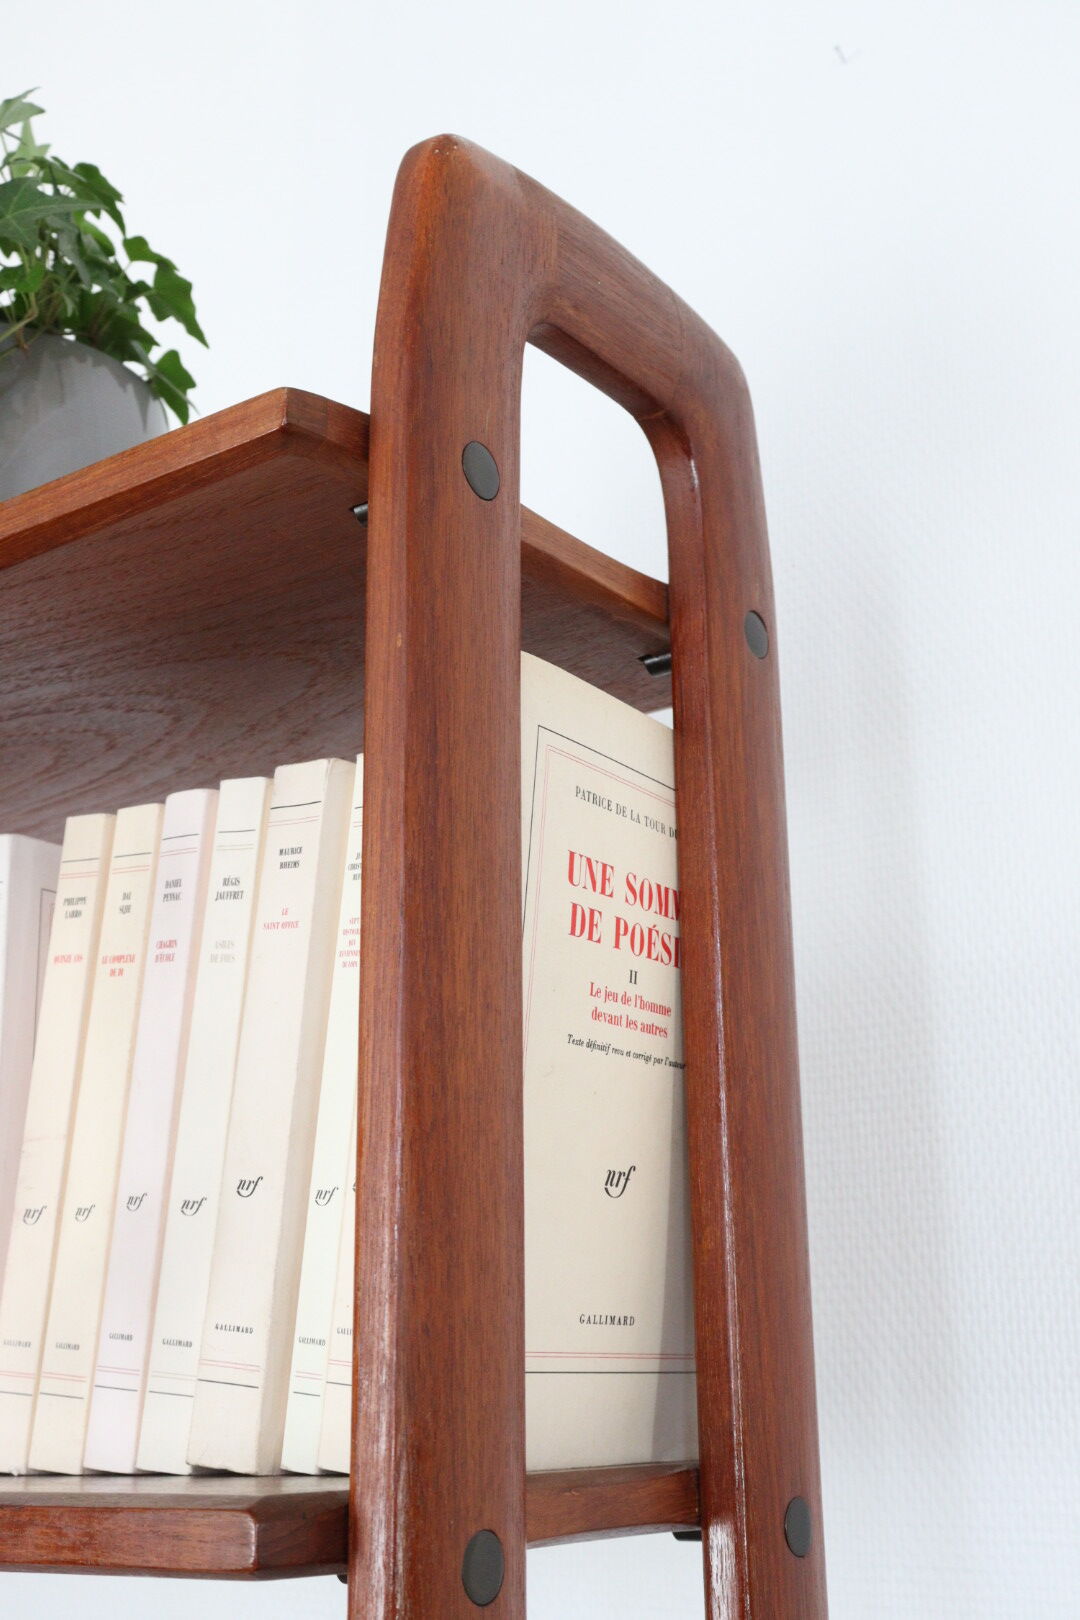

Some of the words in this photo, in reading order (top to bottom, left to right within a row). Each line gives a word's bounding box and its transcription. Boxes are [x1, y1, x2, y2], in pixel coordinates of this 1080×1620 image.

[575, 785, 613, 812] PATRICE
[615, 803, 628, 818] DE
[630, 809, 641, 824] LA
[644, 815, 666, 836] TOUR
[279, 846, 303, 857] MAURICE
[279, 860, 300, 870] RHEIMS
[567, 849, 615, 898] UNE
[165, 879, 182, 889] DANIEL
[222, 875, 241, 887] RÉGIS
[215, 891, 244, 901] JAUFFRET
[281, 908, 289, 916] LE
[262, 922, 280, 931] SAINT
[568, 901, 602, 944] DE
[629, 969, 637, 985] II
[589, 982, 602, 999] Le
[604, 986, 618, 1003] jeu
[620, 991, 632, 1007] de
[634, 994, 672, 1017] l'homme
[591, 1006, 623, 1028] devant
[625, 1014, 638, 1032] les
[640, 1021, 668, 1039] autres
[567, 1033, 585, 1049] Texte
[586, 1039, 611, 1055] définitif
[625, 1049, 632, 1058] et
[632, 1051, 652, 1065] corrigé
[653, 1056, 663, 1066] par
[236, 1175, 264, 1198] nrf
[604, 1165, 636, 1199] nrf
[126, 1192, 148, 1212] nrf
[314, 1186, 339, 1207] nrf
[74, 1204, 96, 1223] nrf
[180, 1197, 208, 1217] nrf
[22, 1205, 48, 1226] nrf
[579, 1313, 635, 1326] GALLIMARD
[214, 1323, 254, 1335] GALLIMARD
[3, 1339, 32, 1349] GALLIMARD
[108, 1332, 133, 1342] GALLIMARD
[162, 1338, 193, 1348] GALLIMARD
[298, 1336, 326, 1347] GALLIMARD
[55, 1341, 80, 1351] GALLIMARD
